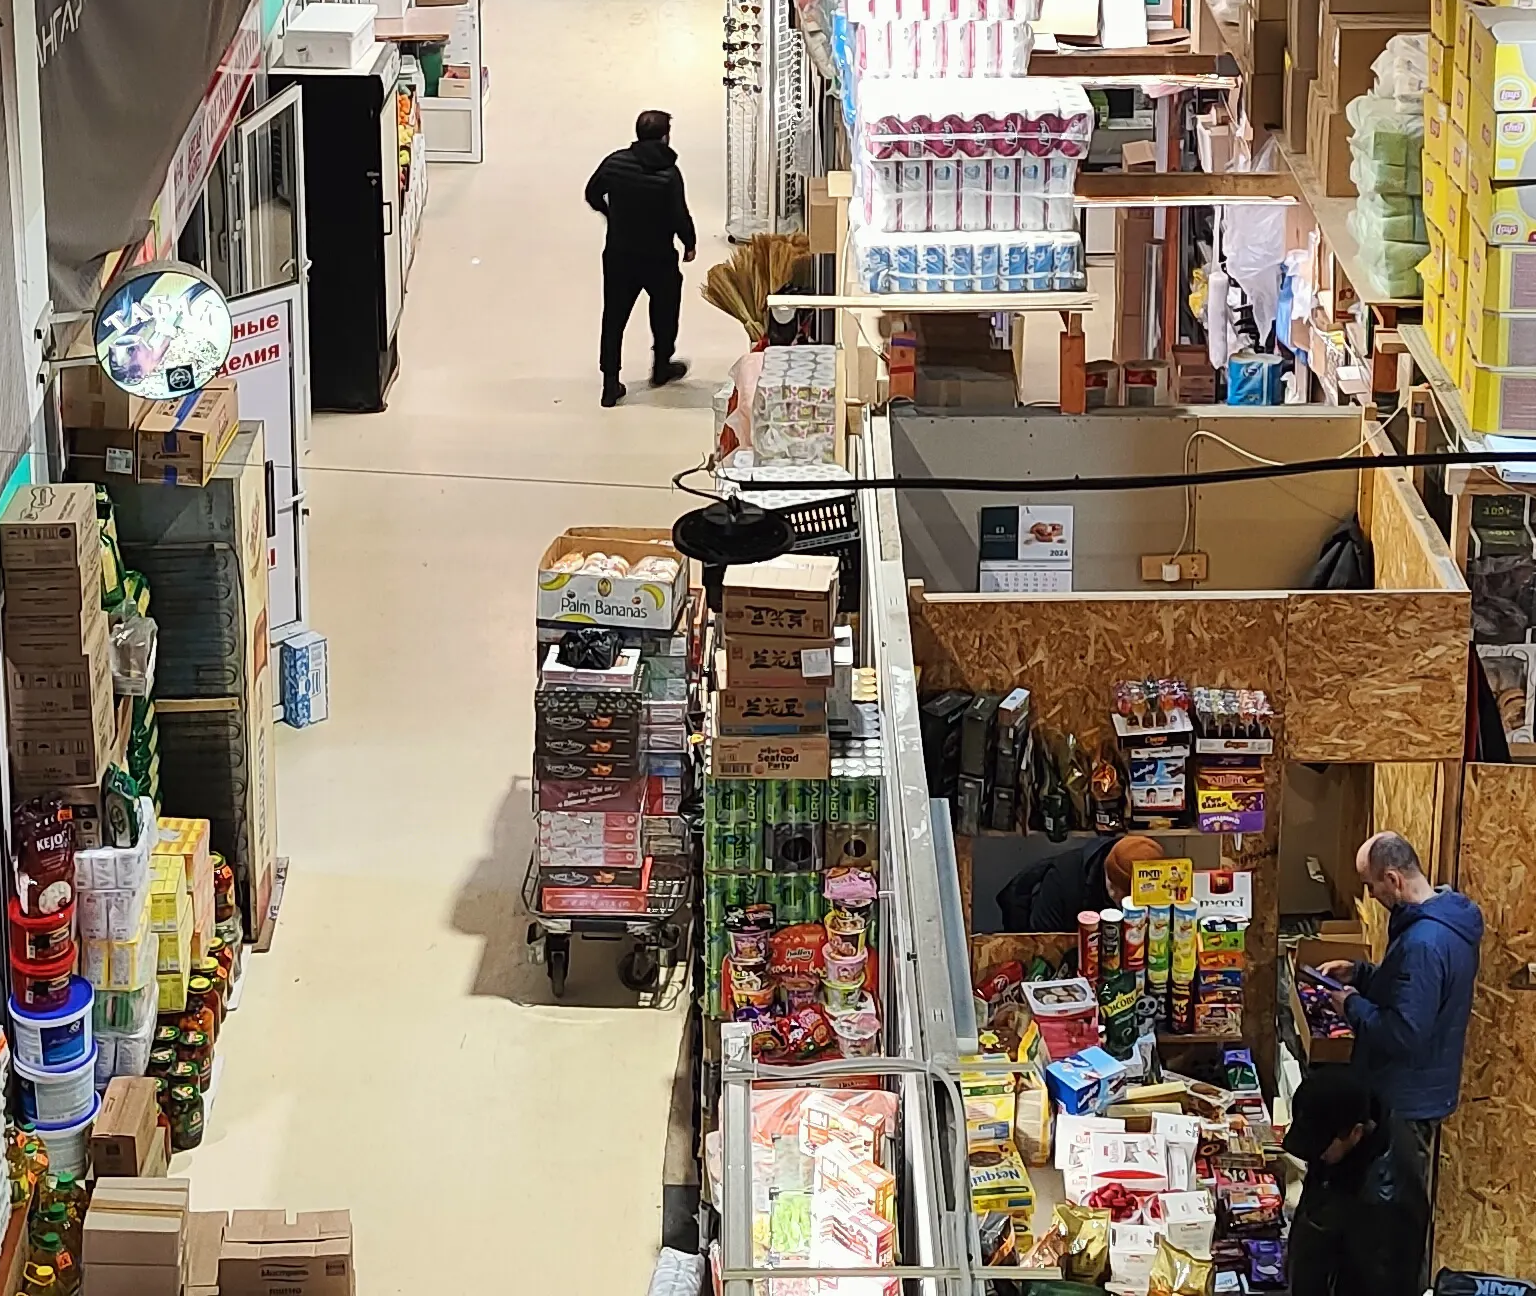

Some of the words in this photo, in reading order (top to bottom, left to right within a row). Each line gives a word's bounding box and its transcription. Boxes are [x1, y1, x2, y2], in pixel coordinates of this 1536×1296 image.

[233, 313, 280, 339] ные
[216, 343, 280, 378] делия
[1049, 549, 1068, 557] 2024
[561, 596, 591, 614] Palm
[595, 600, 648, 619] Bananas
[741, 697, 805, 719] 兰花豆
[757, 752, 799, 764] Seafood
[830, 778, 839, 820] DRIVE
[1199, 897, 1243, 908] merci
